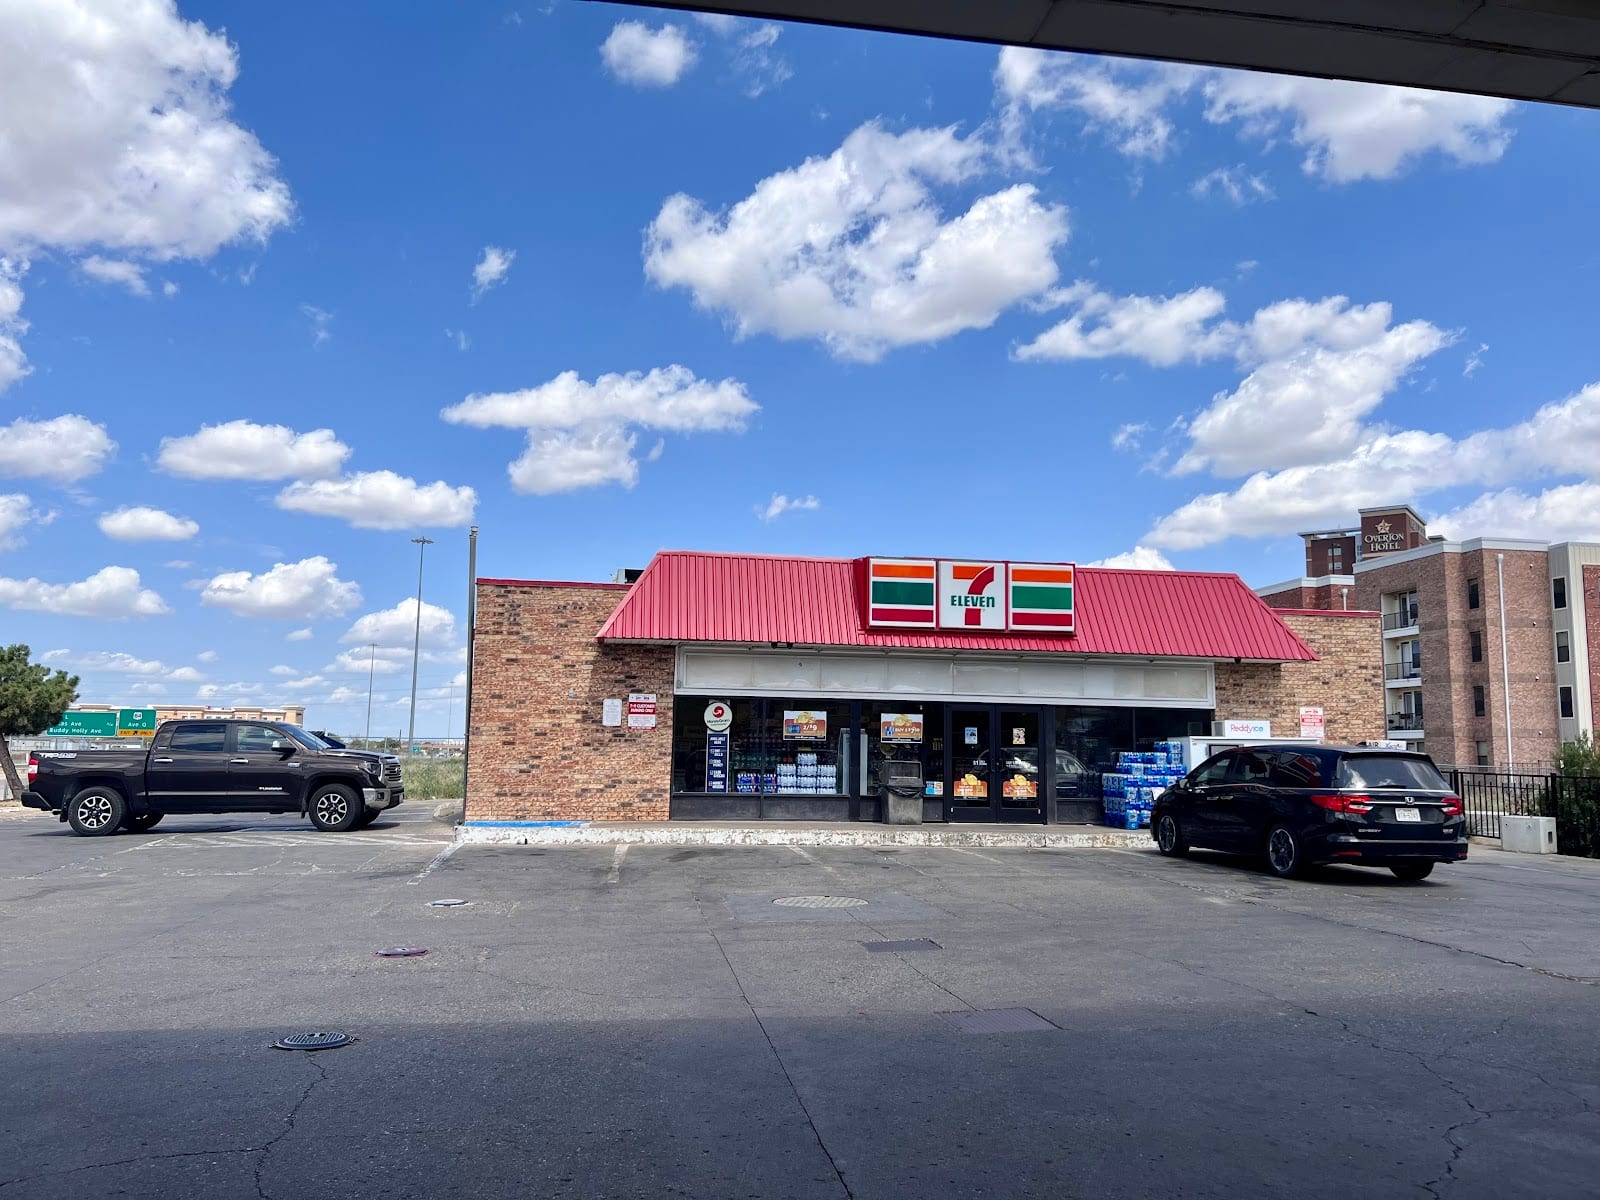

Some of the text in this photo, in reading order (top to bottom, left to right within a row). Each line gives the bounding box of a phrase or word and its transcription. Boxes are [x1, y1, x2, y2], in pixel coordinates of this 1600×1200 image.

[1364, 533, 1404, 543] OVERTON
[1370, 542, 1401, 551] HOTEL
[953, 565, 994, 626] 7
